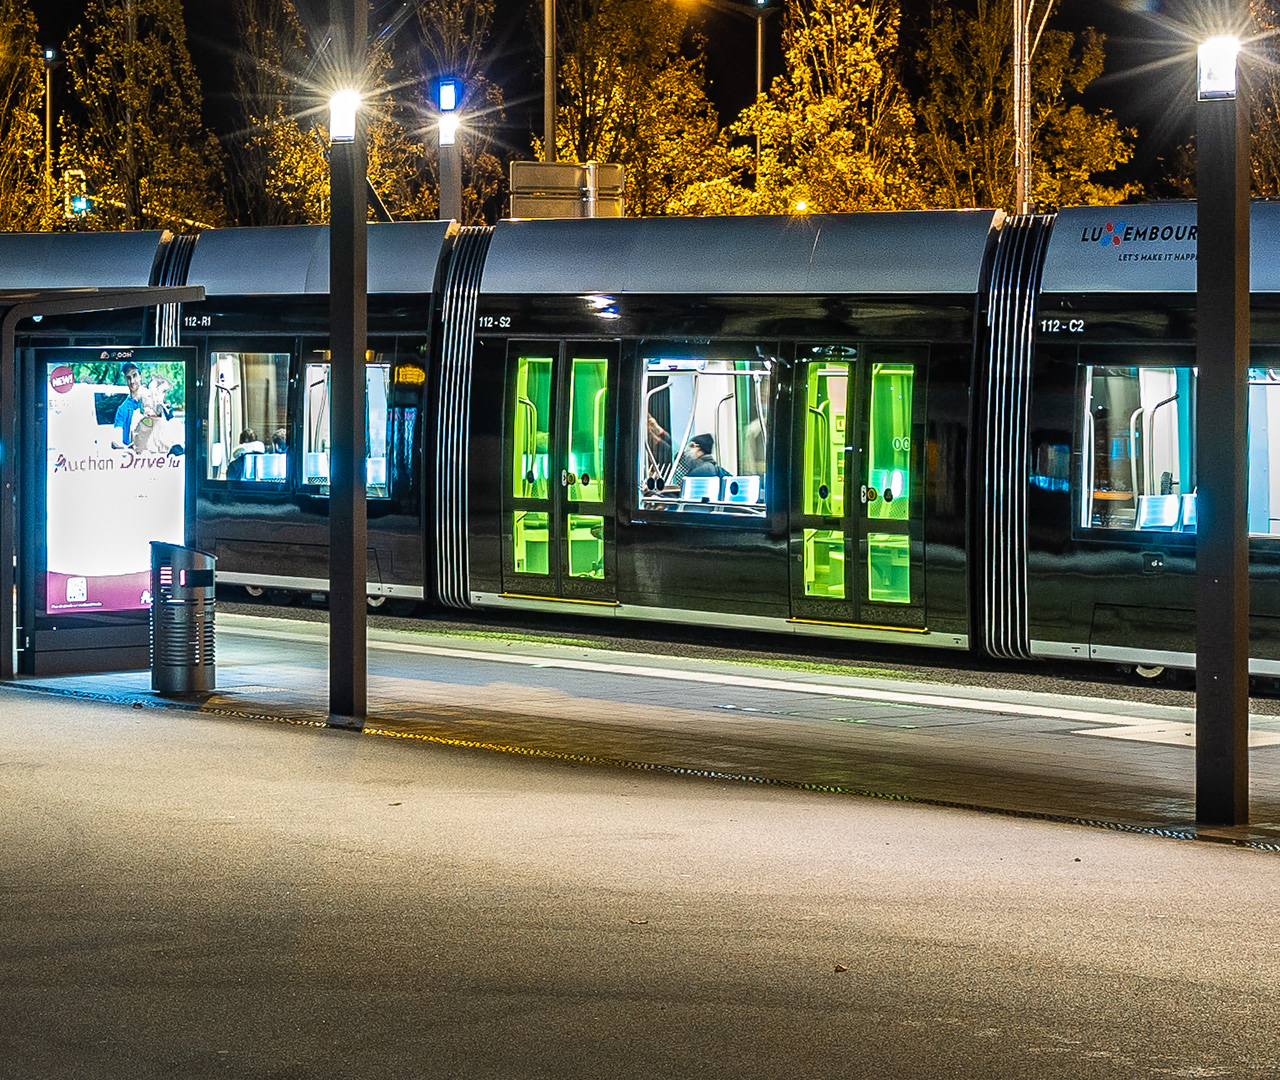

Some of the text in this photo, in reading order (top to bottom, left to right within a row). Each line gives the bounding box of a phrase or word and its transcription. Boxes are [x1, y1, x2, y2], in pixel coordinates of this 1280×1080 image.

[1081, 222, 1197, 247] LUXEMBOUR
[1118, 253, 1197, 262] LET'S MAKE IT HAPP
[52, 373, 74, 387] NEW!
